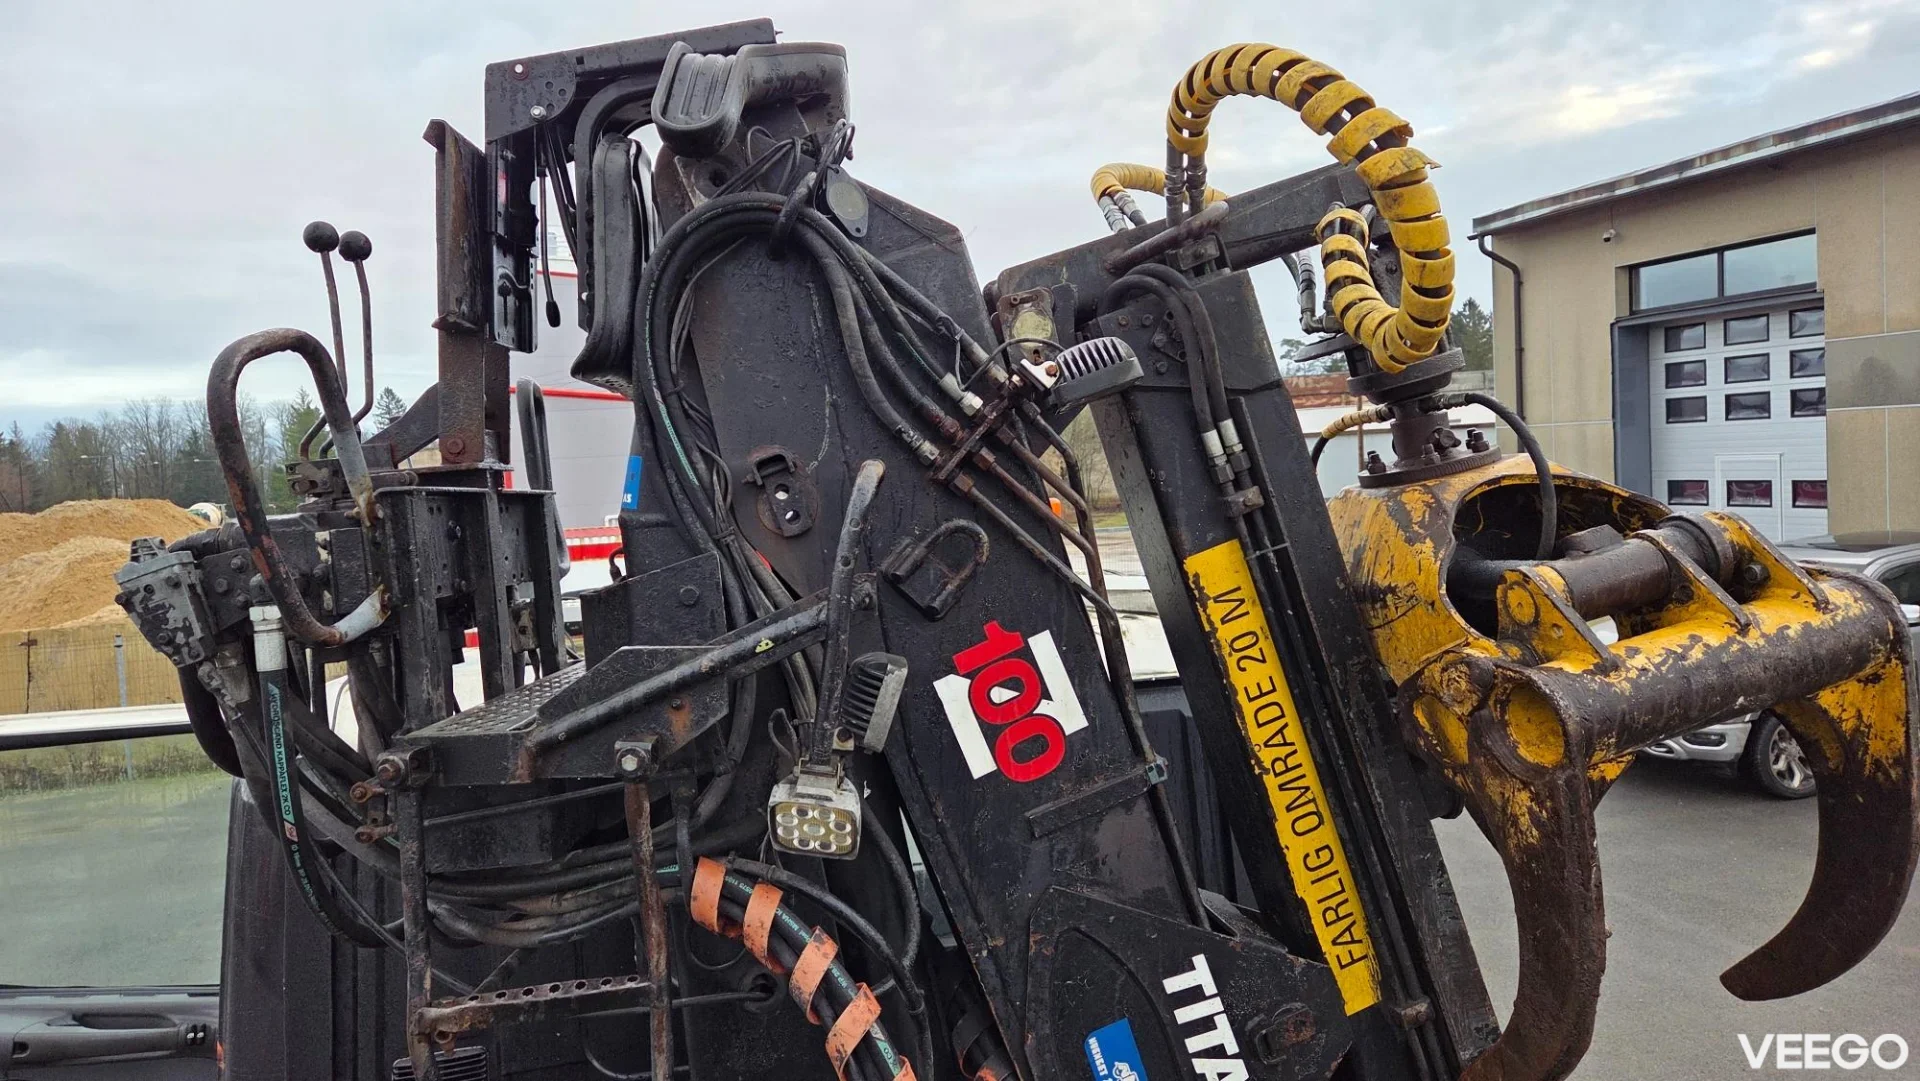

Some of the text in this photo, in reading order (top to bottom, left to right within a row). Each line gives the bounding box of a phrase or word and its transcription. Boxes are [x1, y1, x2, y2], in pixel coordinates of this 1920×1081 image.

[276, 751, 289, 793] KAPPAFLEX
[952, 620, 1066, 783] 100
[1213, 586, 1368, 970] FARLIG OMRÅDE 20 M
